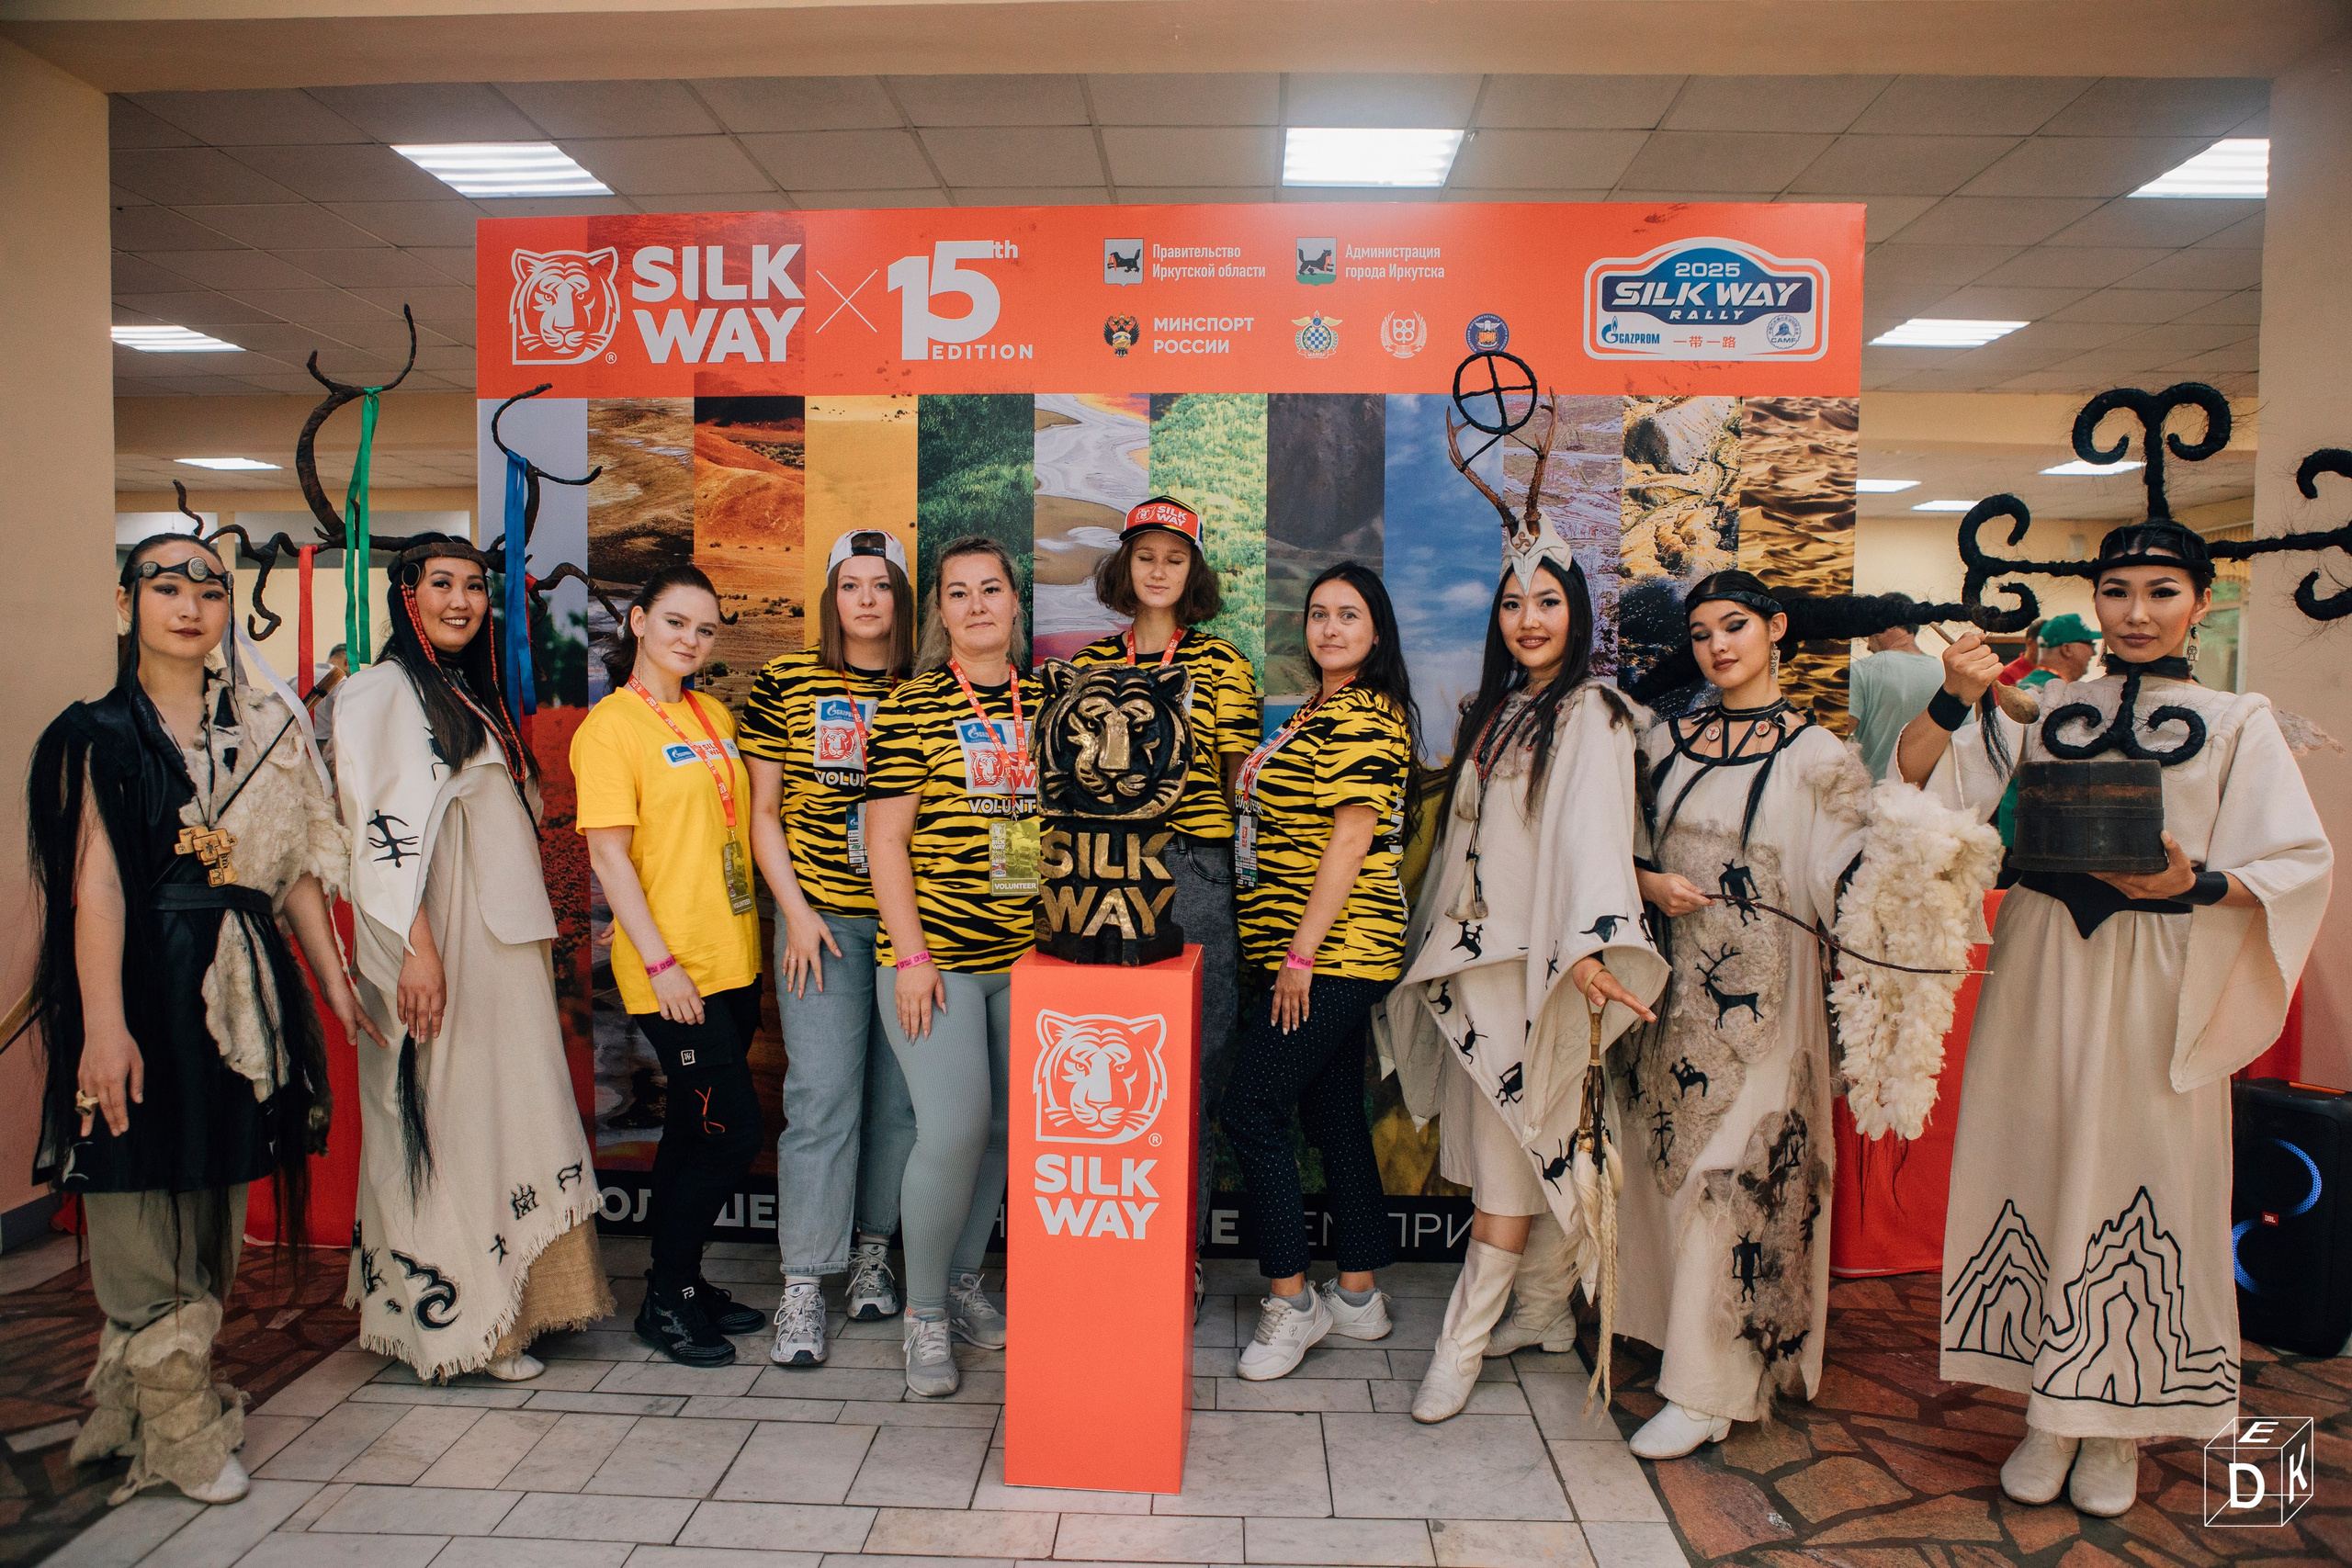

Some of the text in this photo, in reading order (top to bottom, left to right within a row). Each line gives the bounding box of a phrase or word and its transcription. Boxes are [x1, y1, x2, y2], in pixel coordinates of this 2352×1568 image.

[1152, 243, 1241, 261] Правительство
[1345, 243, 1441, 261] Администрация
[632, 244, 805, 302] SILK
[1152, 262, 1266, 280] Иркутской области
[1345, 263, 1445, 280] города Иркутска
[1675, 263, 1740, 277] 2025
[1611, 282, 1803, 307] SILK WAY
[1669, 310, 1745, 321] RALLY
[1154, 317, 1254, 332] МИНСПОРТ
[633, 306, 805, 364] WAY
[1619, 333, 1660, 344] GAZPROM
[1673, 335, 1736, 349] 一带一路
[933, 344, 1034, 359] EDITION
[1154, 339, 1229, 354] РОССИИ
[1157, 513, 1187, 526] WAY
[1158, 505, 1187, 521] SILK
[702, 742, 717, 750] SIL
[968, 798, 1039, 814] VOLUNT
[1037, 830, 1176, 882] SILK
[1039, 886, 1177, 940] WAY
[1035, 1153, 1159, 1198] SILK
[1035, 1196, 1160, 1240] WAY
